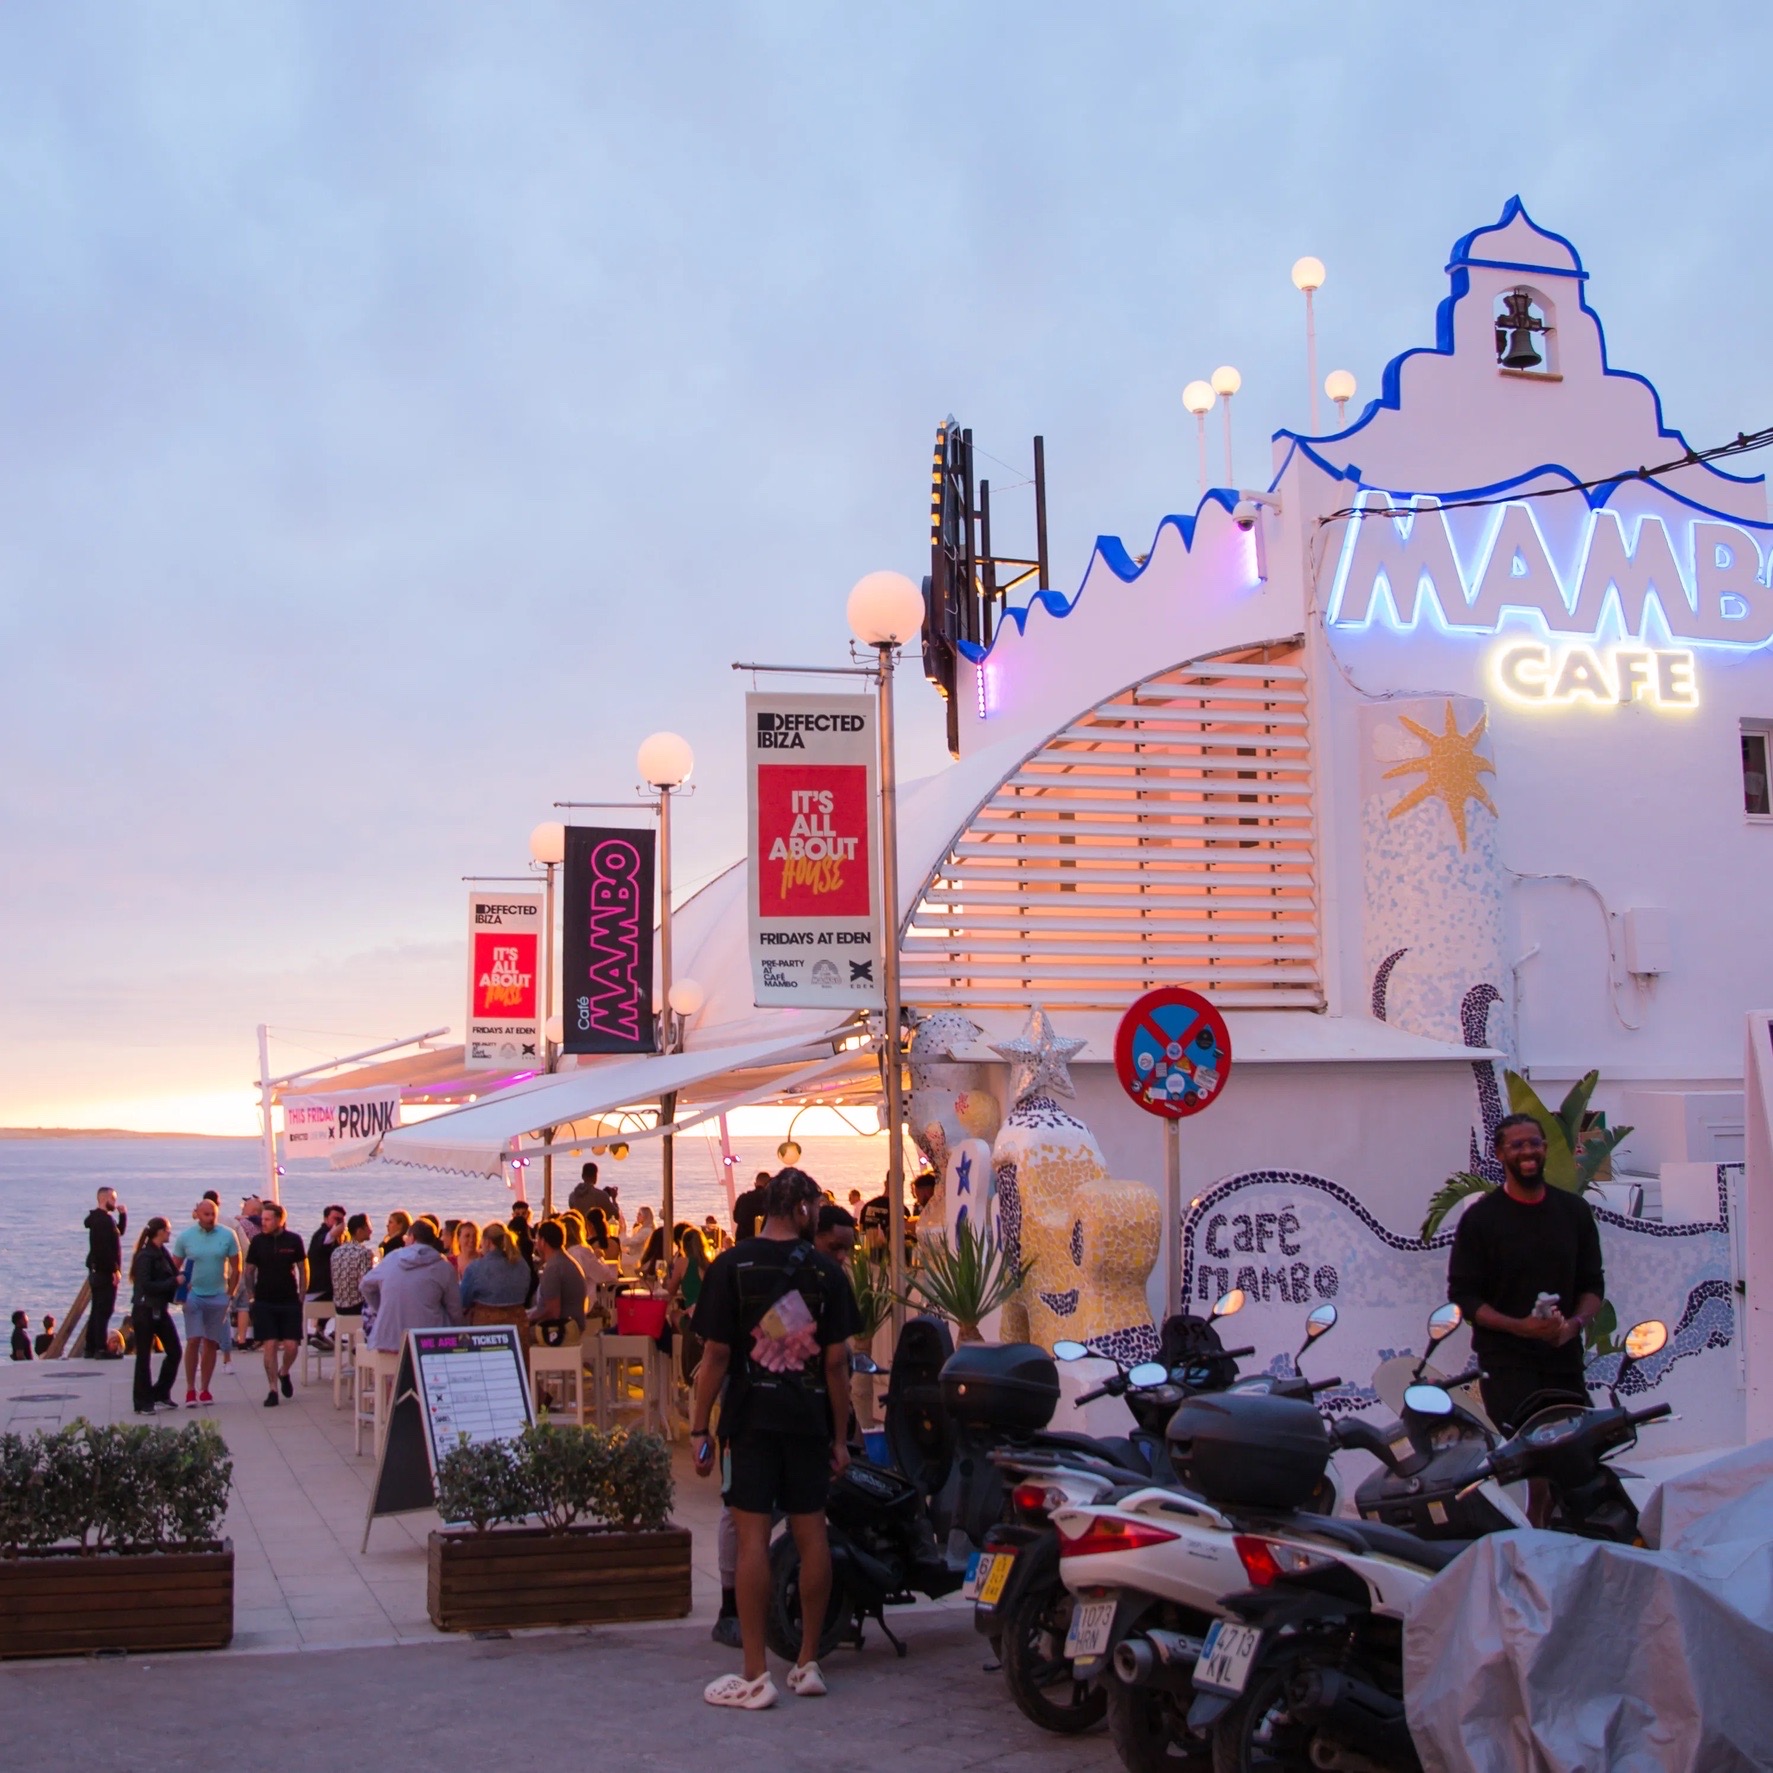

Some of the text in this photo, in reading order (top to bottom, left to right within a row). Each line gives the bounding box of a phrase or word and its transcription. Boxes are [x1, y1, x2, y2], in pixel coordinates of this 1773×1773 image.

[1327, 488, 1773, 651] MAMB
[1499, 645, 1701, 708] CAFE
[758, 713, 865, 732] DEFECTED
[757, 731, 805, 749] IBIZA
[791, 790, 834, 814] IT'S
[789, 814, 836, 837] ALL
[769, 837, 858, 861] ABOUT
[476, 904, 537, 915] DEFECTED
[475, 914, 502, 925] IBIZA
[590, 839, 640, 1042] MAMBO
[760, 931, 871, 945] FRIDAYS AT EDEN
[493, 947, 518, 961] IT'S
[491, 961, 519, 974] ALL
[761, 959, 804, 968] PRE-PARTY
[479, 974, 532, 988] ABOUT
[764, 980, 798, 988] MAMBO
[577, 996, 590, 1031] Café
[472, 1026, 503, 1034] FRIDAYS
[516, 1027, 536, 1035] EDEN
[289, 1106, 335, 1124] THIS FRIDAY
[338, 1101, 395, 1139] PRUNK
[422, 1334, 508, 1348] WE ARE TICKETS
[1081, 1604, 1112, 1627] 1073
[1217, 1627, 1255, 1657] 4713
